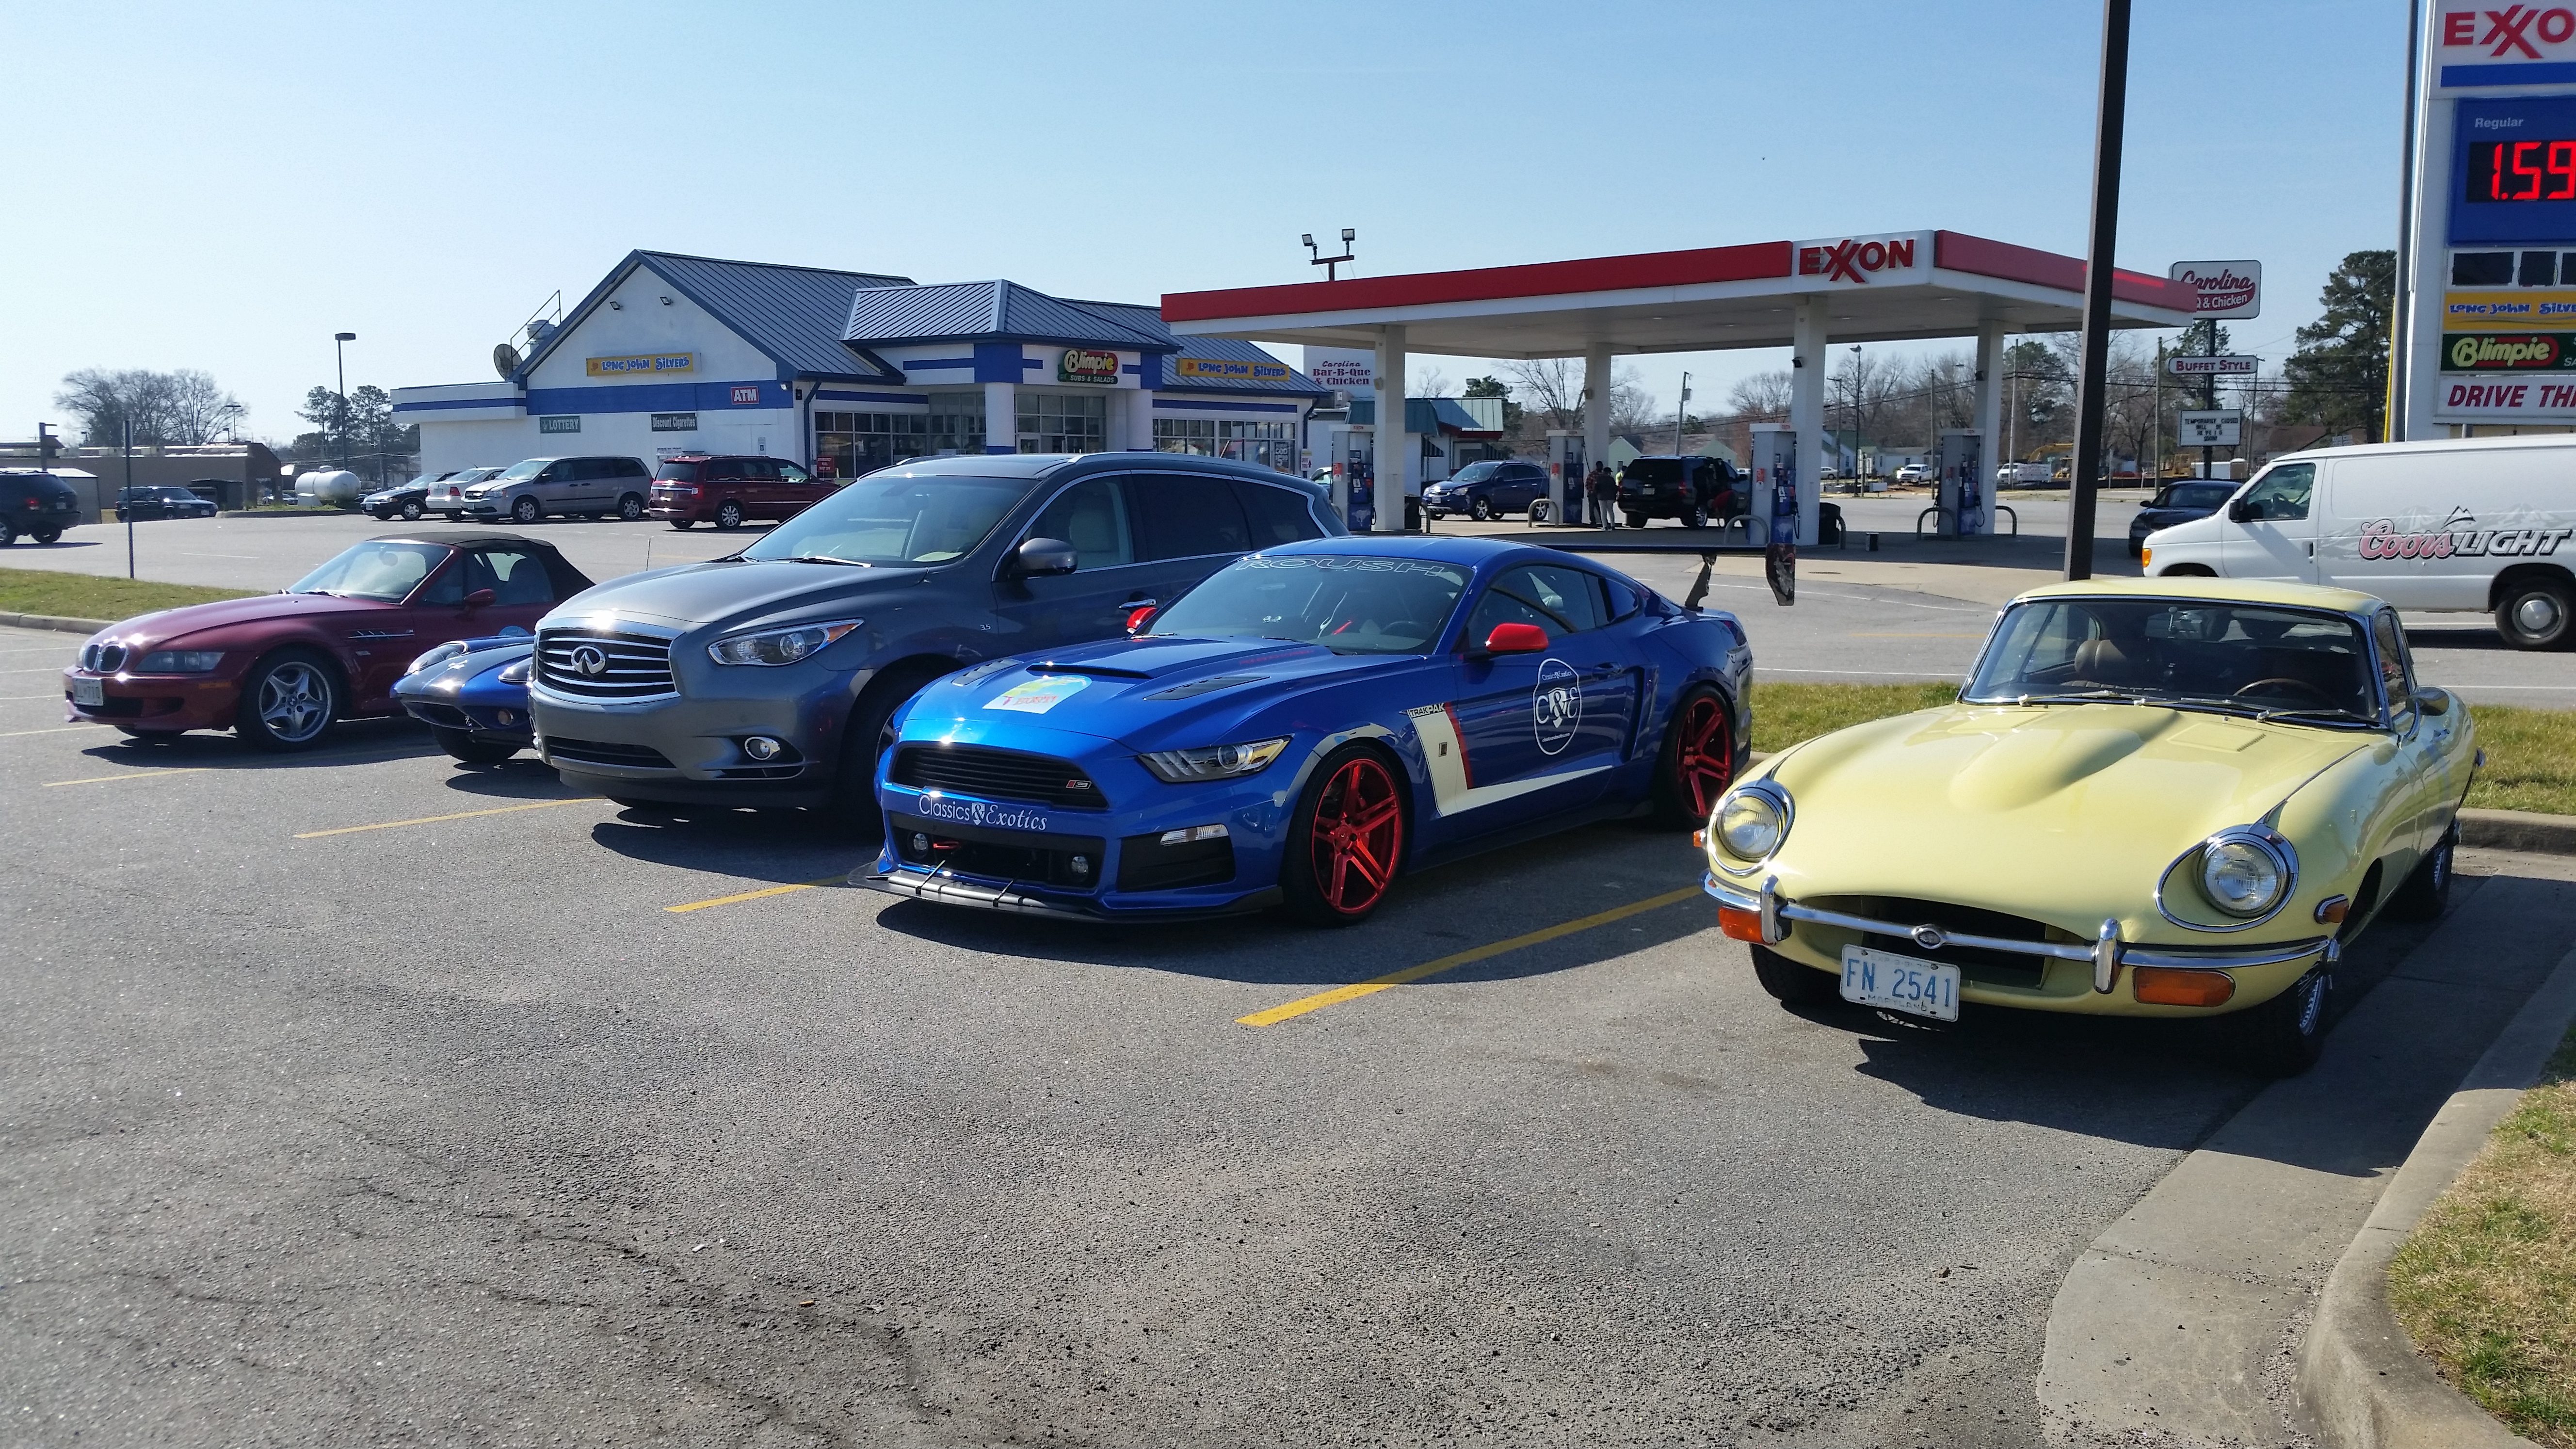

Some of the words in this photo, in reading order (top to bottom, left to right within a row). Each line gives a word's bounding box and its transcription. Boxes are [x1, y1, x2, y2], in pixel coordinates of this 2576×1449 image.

[2475, 117, 2524, 129] Regular
[2491, 141, 2576, 200] 1.59
[1799, 240, 1915, 283] EXXON
[2181, 269, 2253, 290] Carolina
[2203, 298, 2210, 308] &
[2212, 294, 2247, 308] Chicken
[2449, 304, 2486, 313] LONG
[2489, 303, 2530, 315] JOHN
[2452, 337, 2550, 367] Blimpie
[602, 361, 624, 371] LONG
[626, 358, 650, 372] JOHN
[1064, 350, 1114, 374] Blimpie
[1198, 363, 1222, 373] LONG
[1224, 364, 1248, 375] JOHN
[2176, 360, 2216, 371] BUFFET
[2219, 360, 2251, 370] STYLE
[733, 389, 757, 402] ATM
[2447, 385, 2528, 407] DRIVE
[548, 418, 580, 431] LOTTERY
[653, 416, 671, 428] Discount
[673, 415, 695, 430] Cigarettes
[2359, 519, 2455, 561] Coors
[2454, 529, 2573, 557] LIGHT
[1236, 558, 1445, 576] ROUSH
[1536, 695, 1549, 724] C
[919, 794, 970, 821] Classics
[985, 805, 1047, 830] Exotics
[1847, 958, 1875, 992] FN
[1892, 968, 1950, 1007] 2541
